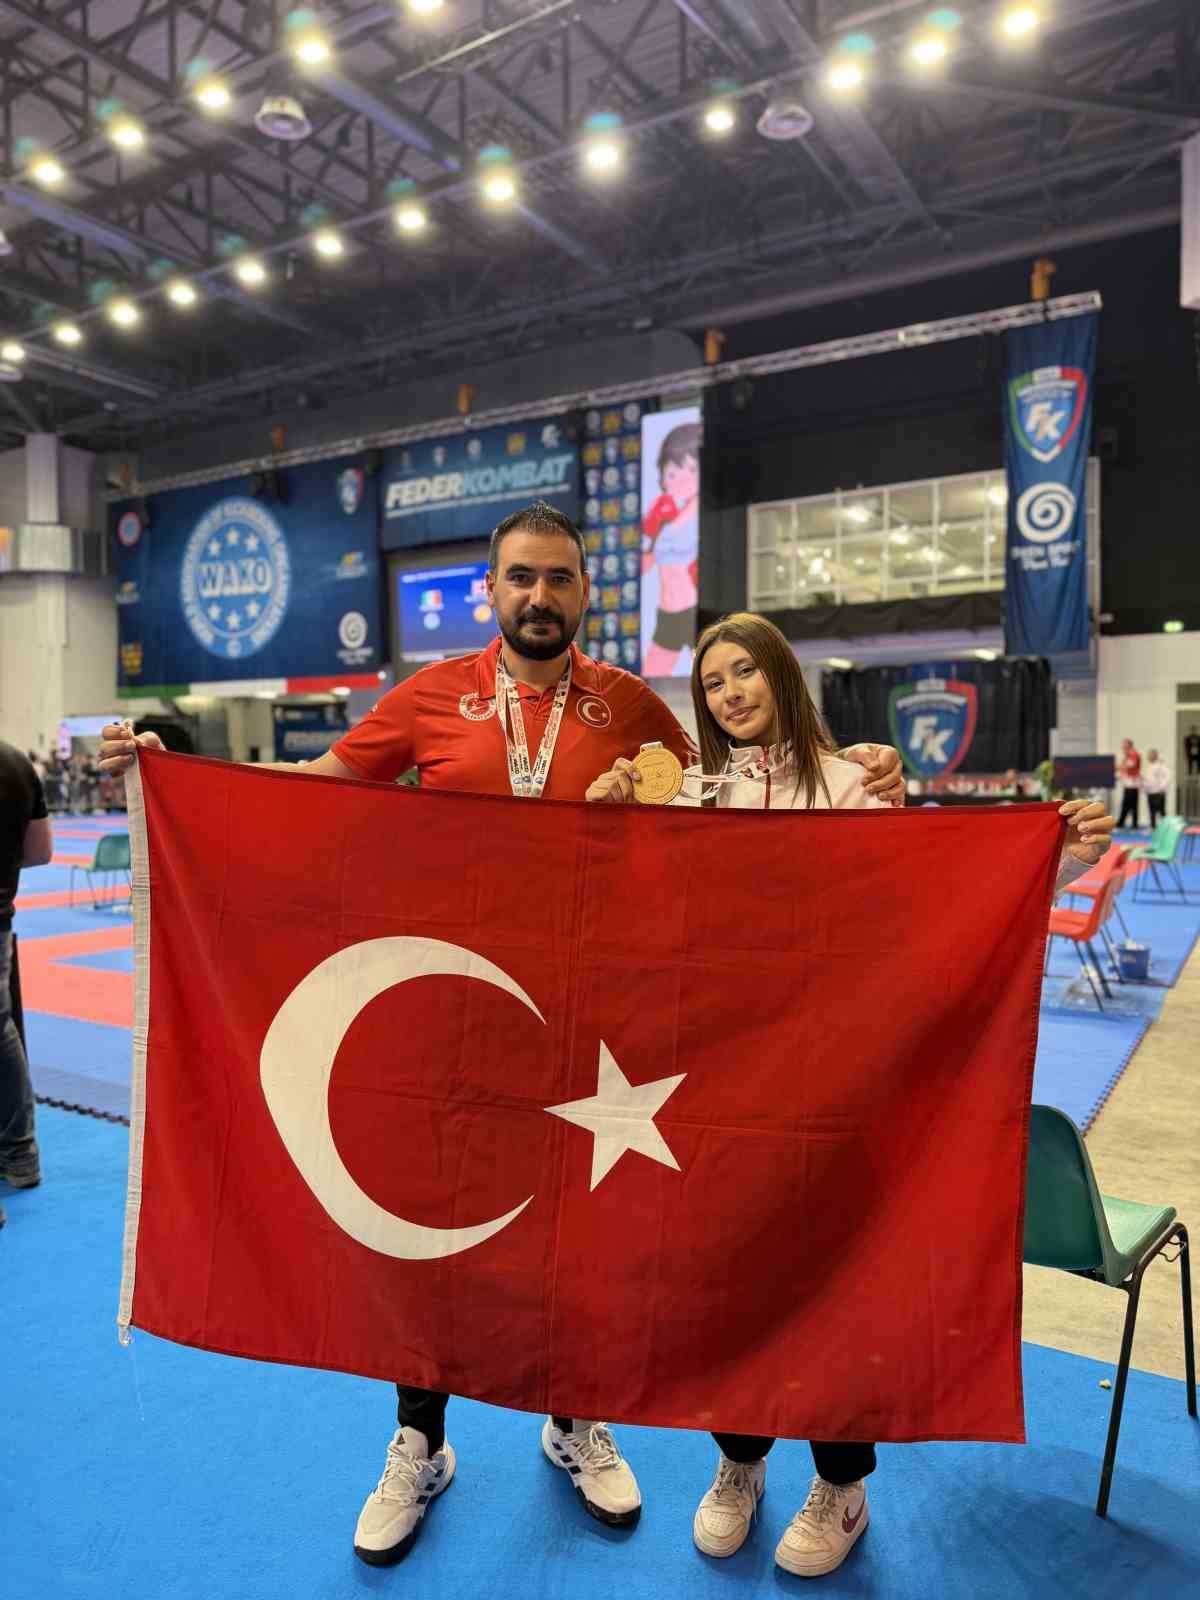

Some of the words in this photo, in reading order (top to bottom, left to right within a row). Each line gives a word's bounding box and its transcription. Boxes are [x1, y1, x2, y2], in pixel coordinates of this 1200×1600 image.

[1025, 401, 1066, 441] FK
[385, 454, 574, 510] FEDERKOMBAT
[909, 714, 954, 763] FK
